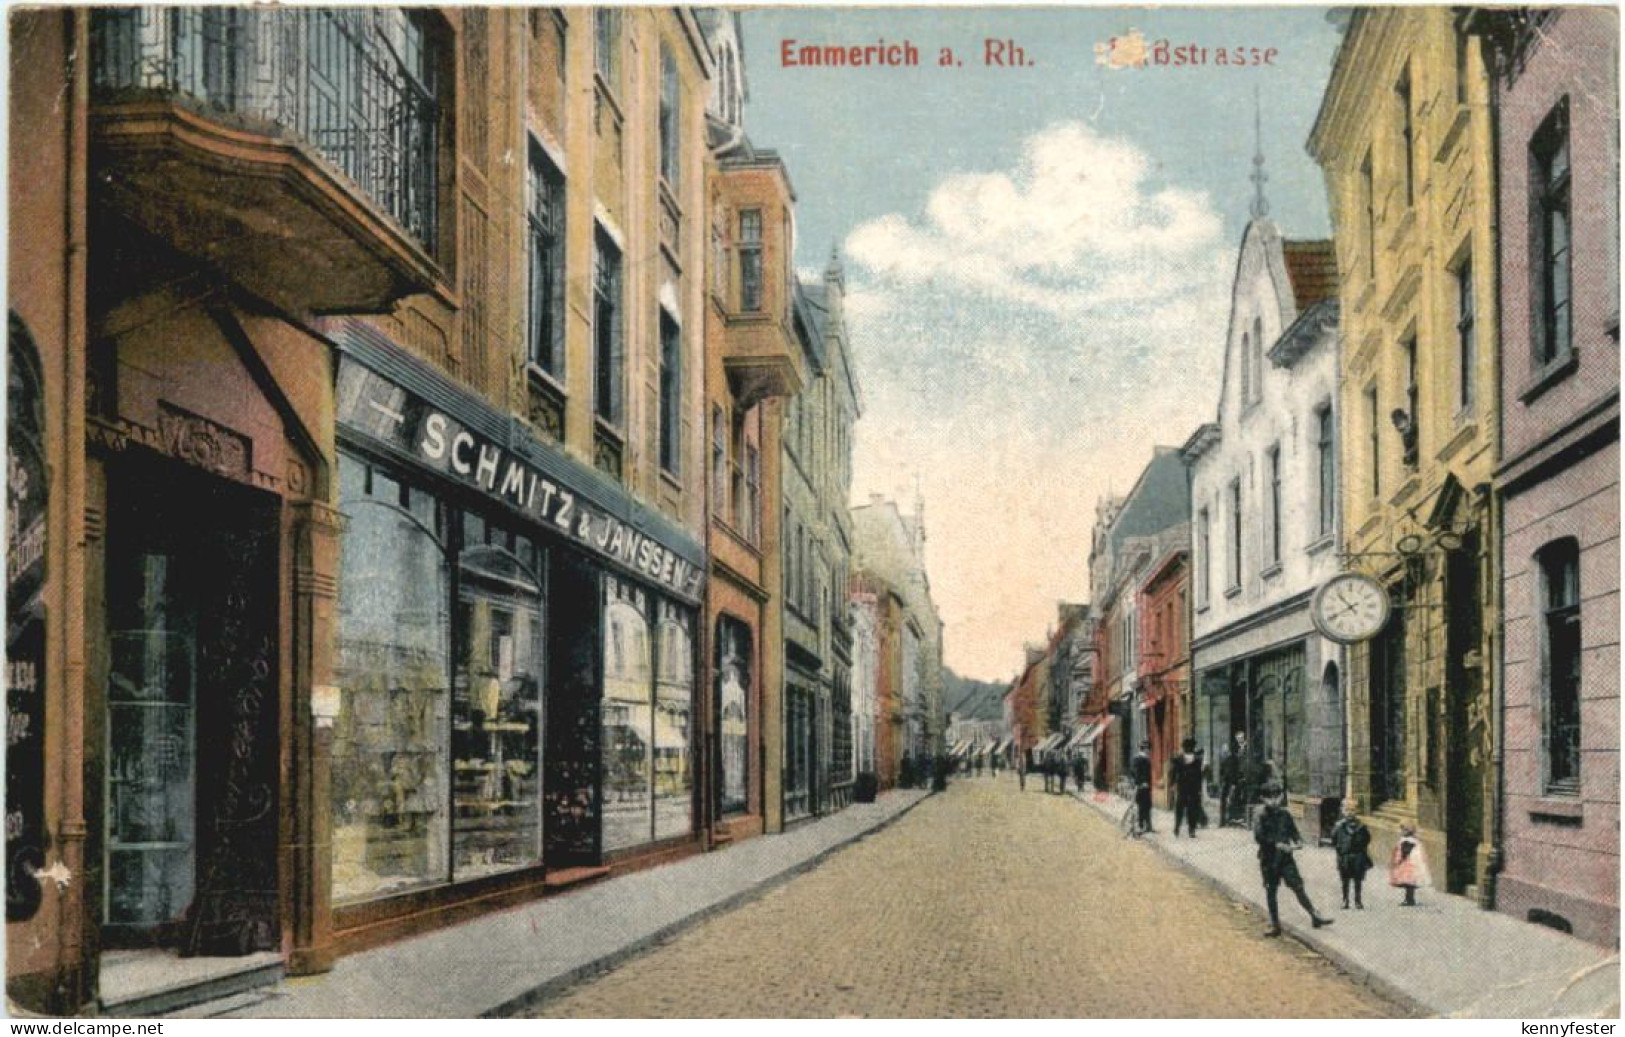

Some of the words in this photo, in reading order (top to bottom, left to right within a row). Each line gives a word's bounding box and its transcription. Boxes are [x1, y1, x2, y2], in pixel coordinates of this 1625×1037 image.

[421, 412, 575, 530] SCHMITZ
[577, 518, 592, 542] &
[597, 516, 688, 588] JANSSEN
